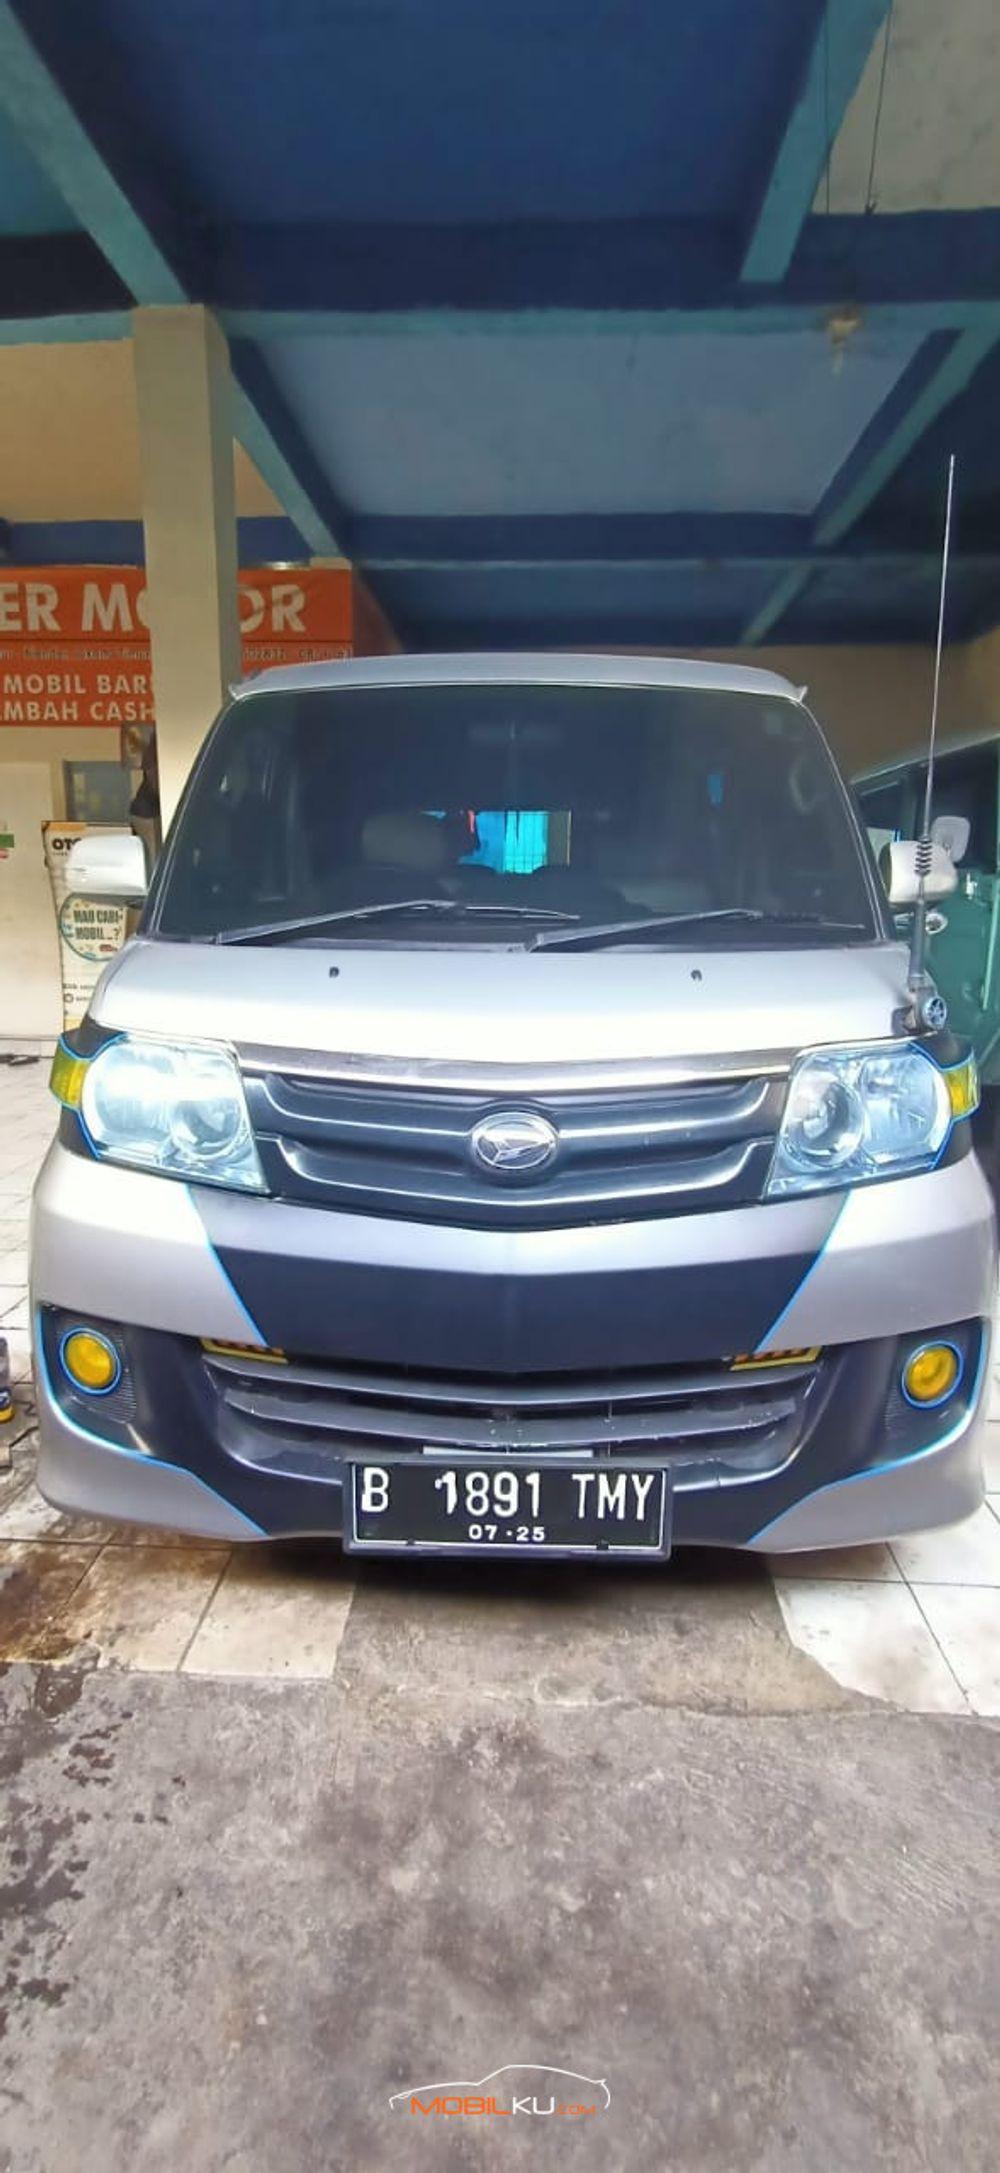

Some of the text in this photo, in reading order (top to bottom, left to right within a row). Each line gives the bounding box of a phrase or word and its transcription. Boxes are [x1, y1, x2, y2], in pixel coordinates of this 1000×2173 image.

[4, 673, 153, 694] MOBIL BAR
[0, 701, 78, 720] MBAH
[361, 1467, 655, 1521] B 1891 TMY
